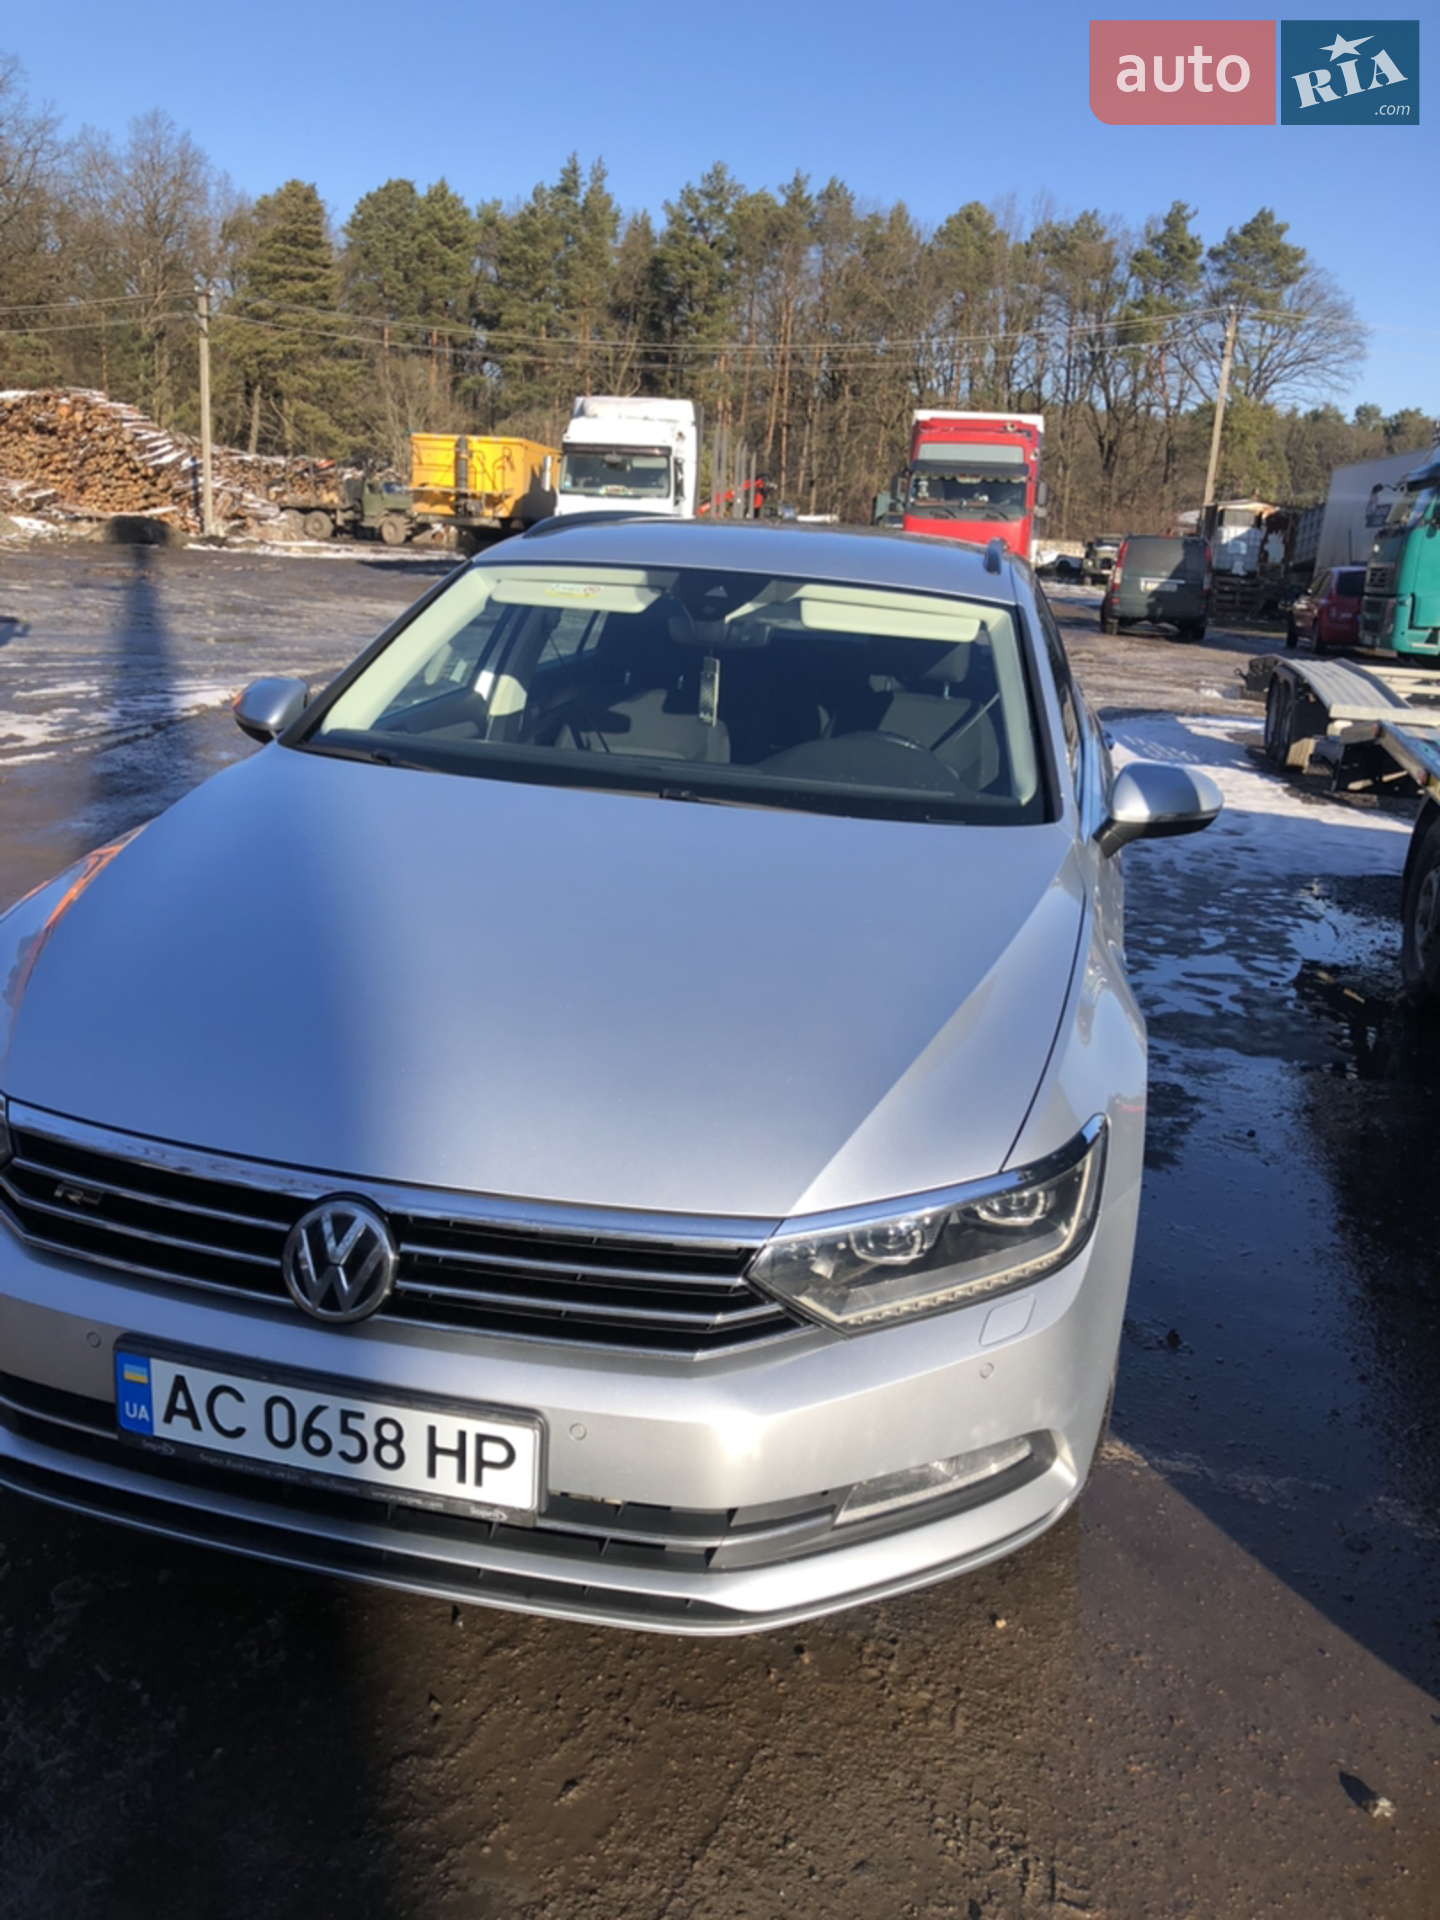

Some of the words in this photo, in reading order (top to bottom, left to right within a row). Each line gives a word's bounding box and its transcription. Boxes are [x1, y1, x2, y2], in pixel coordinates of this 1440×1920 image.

[124, 1400, 150, 1422] UA
[163, 1373, 247, 1440] AC
[264, 1394, 406, 1471] 0658
[426, 1424, 517, 1488] HP
